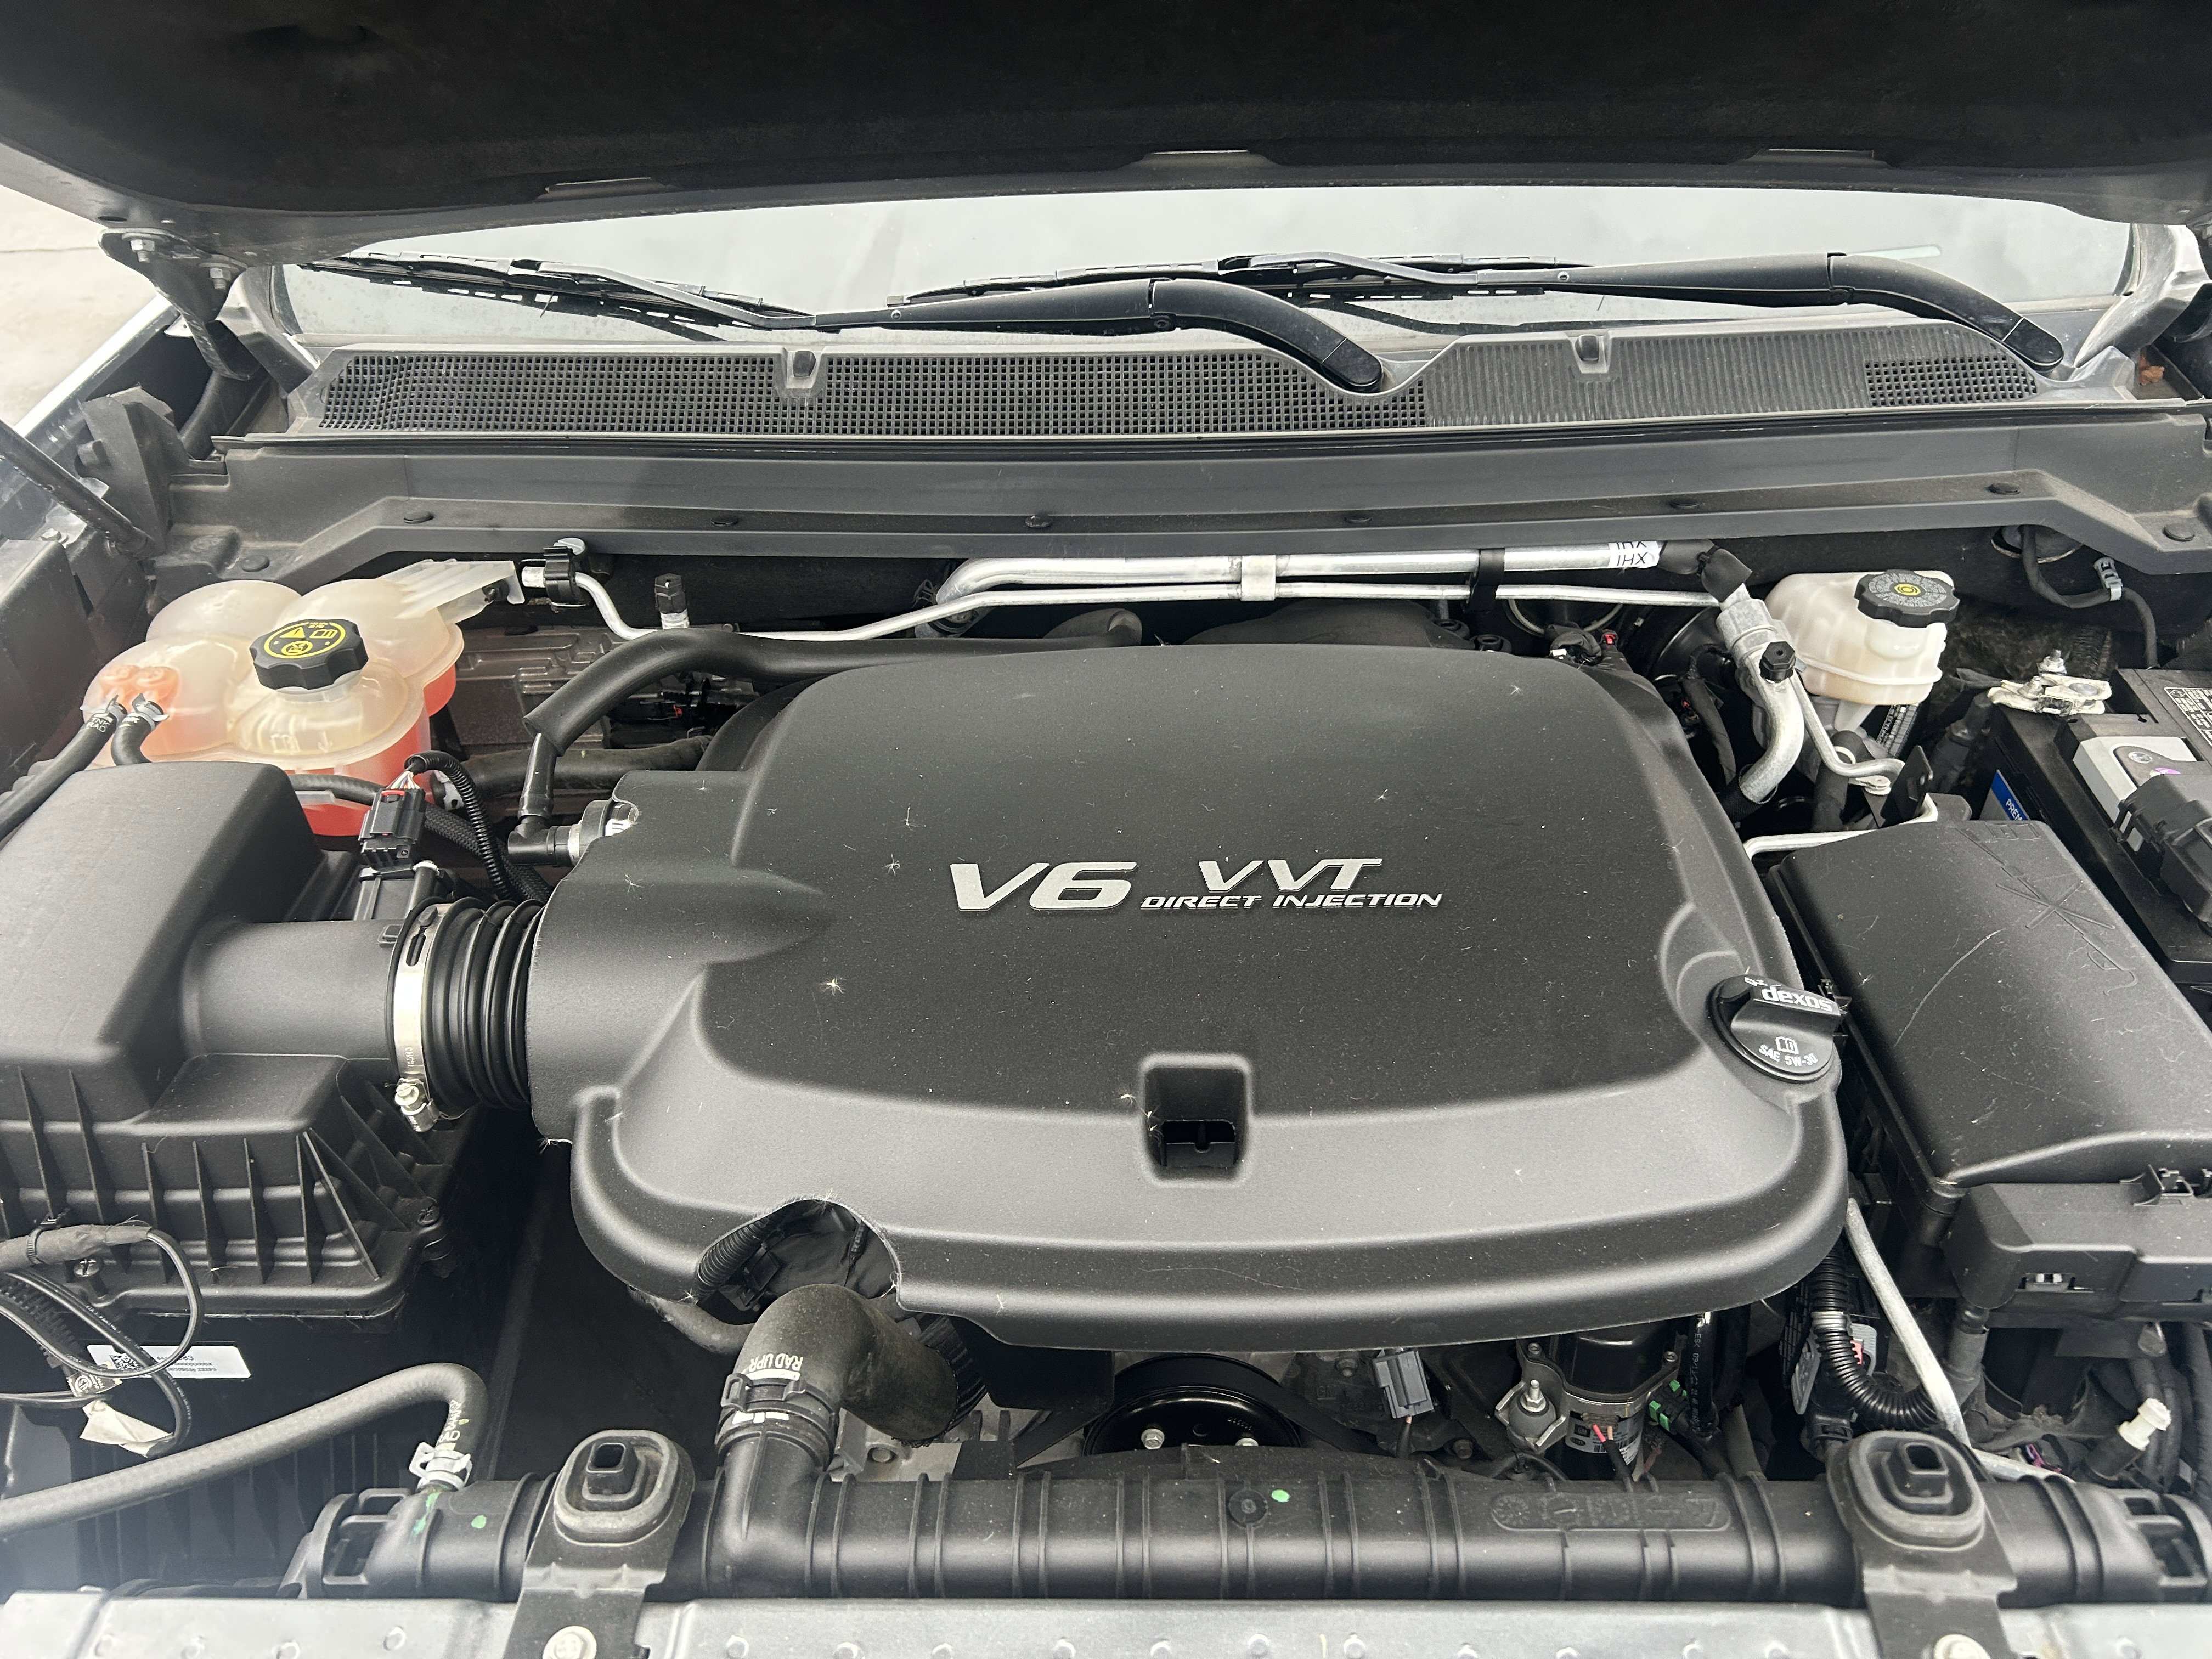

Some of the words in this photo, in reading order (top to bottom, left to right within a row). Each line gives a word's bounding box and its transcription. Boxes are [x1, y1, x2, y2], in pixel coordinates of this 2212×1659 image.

[950, 861, 1138, 911] V6
[1198, 857, 1383, 894] VVT
[1141, 894, 1263, 911] DIRECT
[1272, 893, 1443, 909] INJECTION
[1761, 986, 1833, 1012] dexos
[1758, 1044, 1781, 1062] SAE
[1785, 1053, 1819, 1067] 5W-30
[748, 1353, 774, 1372] UPR
[774, 1353, 803, 1372] RAD
